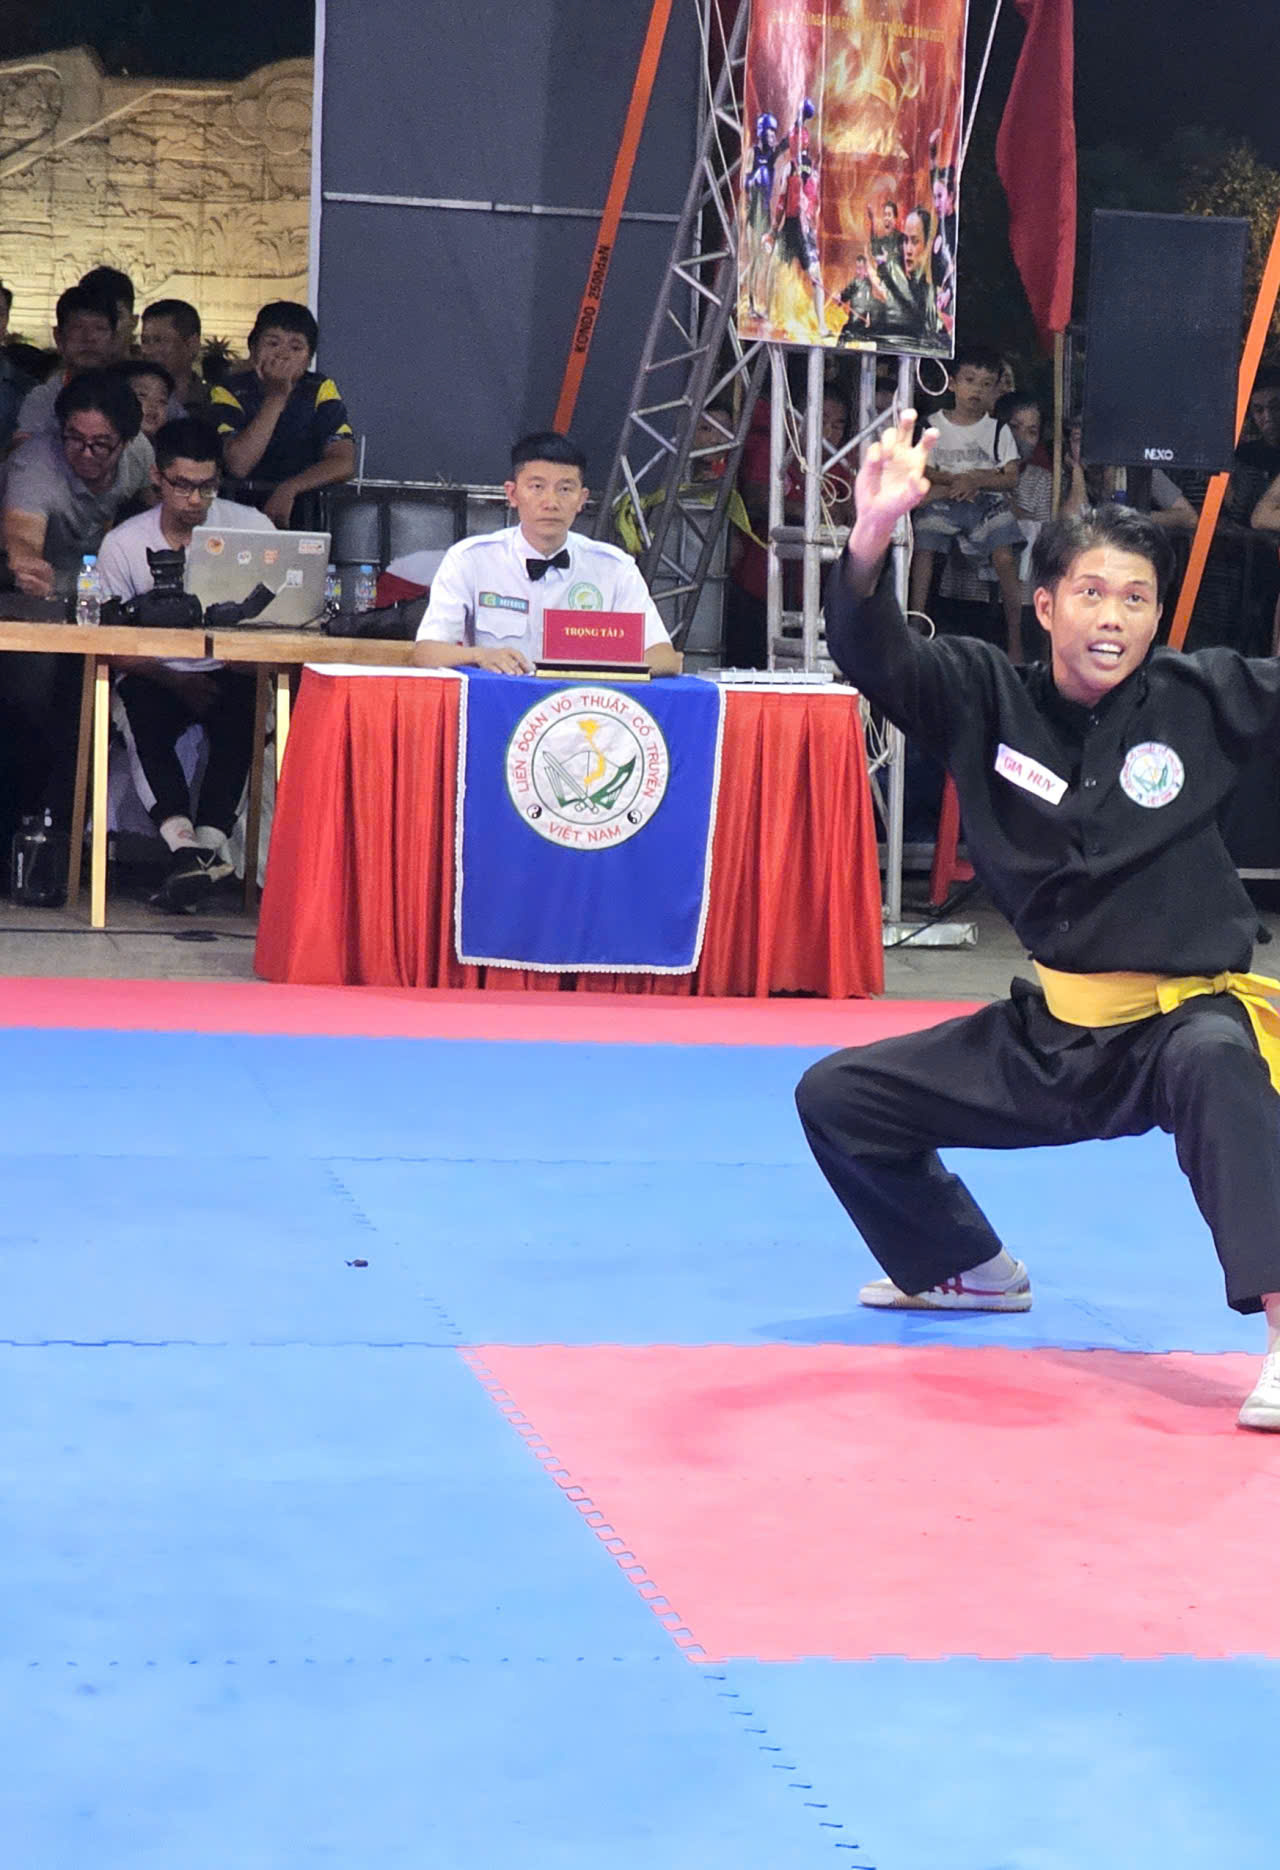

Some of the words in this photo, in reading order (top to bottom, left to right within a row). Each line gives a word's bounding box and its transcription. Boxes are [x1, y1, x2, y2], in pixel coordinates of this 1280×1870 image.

[574, 306, 597, 353] KONDO
[1144, 447, 1174, 461] NEXO
[565, 626, 599, 638] TRỌNG
[601, 626, 617, 638] TÀI
[580, 695, 630, 715] THUẬT
[517, 712, 549, 752] ĐOÀN
[512, 759, 529, 793] LIÊN
[643, 742, 662, 799] TRUYỀN
[1003, 756, 1024, 777] GIA
[1027, 769, 1057, 792] HUY
[549, 821, 582, 842] VIỆT
[587, 824, 622, 843] NAM
